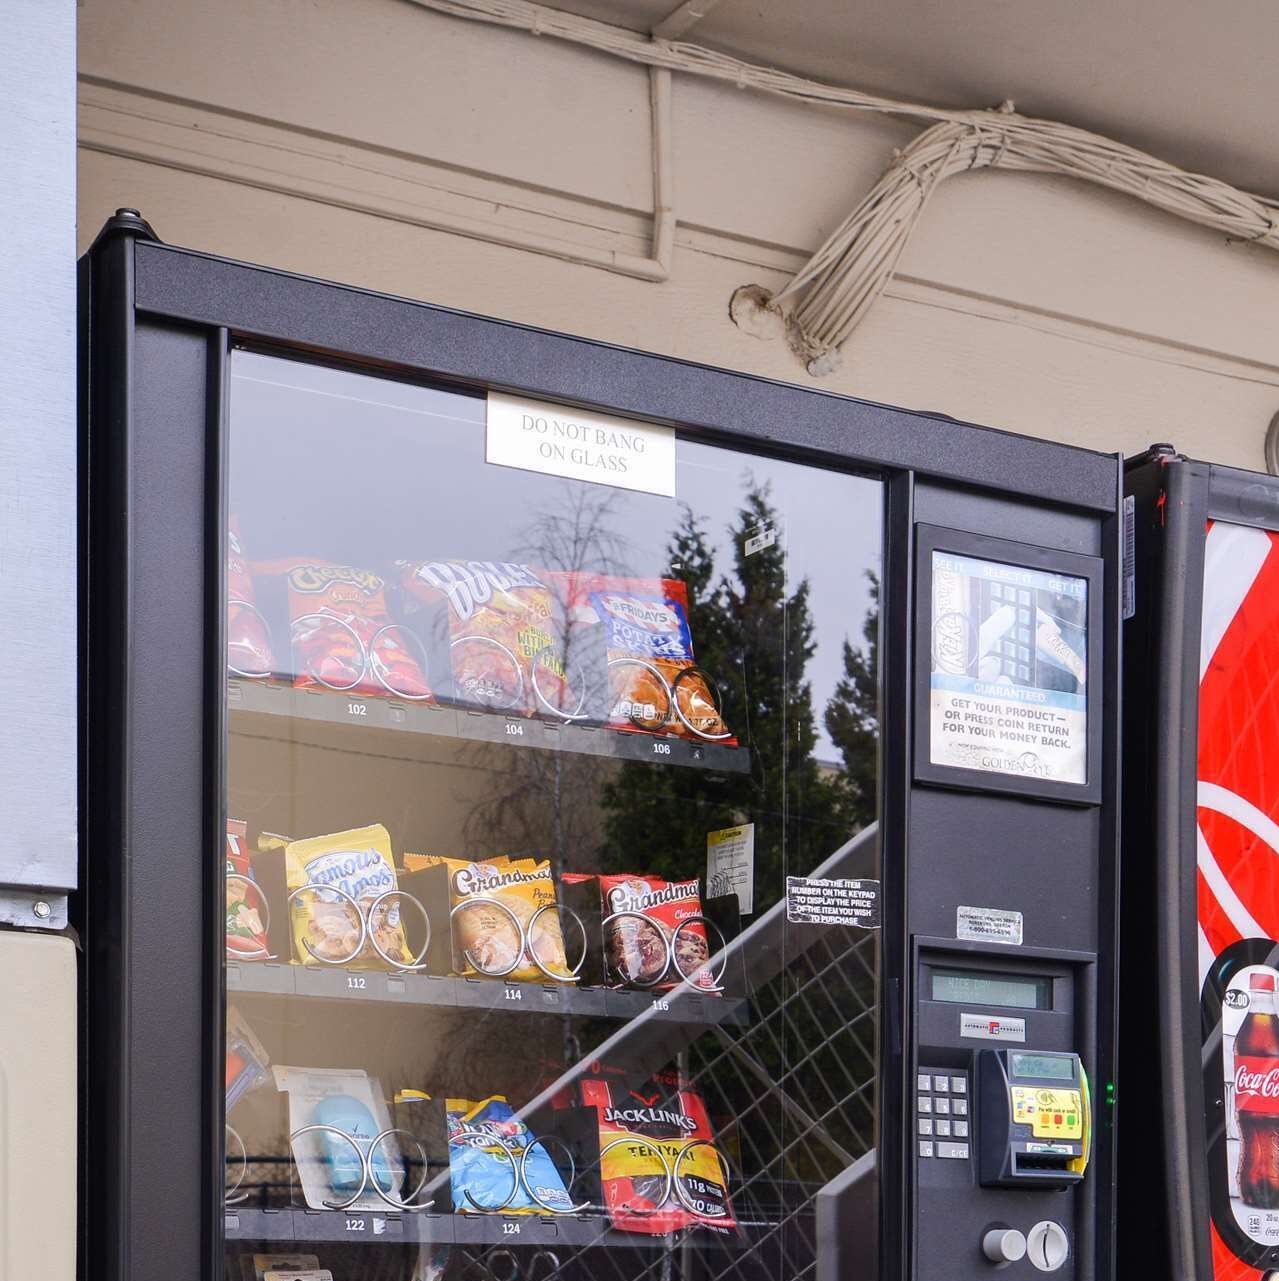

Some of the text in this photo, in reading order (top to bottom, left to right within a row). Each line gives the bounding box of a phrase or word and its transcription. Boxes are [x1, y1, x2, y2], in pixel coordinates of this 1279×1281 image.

[522, 415, 645, 453] DO NOT BANG
[539, 442, 628, 473] ON GLASS
[348, 703, 367, 716] 102
[951, 698, 1002, 714] GET YOUR
[505, 724, 523, 736] 104
[944, 710, 1070, 737] OR PRESS COIN RETURN
[942, 722, 965, 734] FOR
[968, 725, 996, 739] YOUR
[1000, 731, 1037, 745] MONEY
[653, 743, 670, 755] 106
[338, 869, 393, 899] Amos
[830, 880, 843, 888] THE
[845, 881, 861, 889] ITEM
[791, 886, 876, 899] NUMBER ON THE KEYPAD
[807, 897, 836, 906] DISPLAY
[836, 898, 850, 906] THE
[851, 899, 871, 908] PRICE
[808, 906, 821, 914] THE
[822, 907, 838, 915] ITEM
[838, 907, 854, 916] YOU
[854, 909, 872, 917] WISH
[811, 915, 858, 925] TO PURCHASE
[347, 977, 367, 989] 112
[504, 989, 522, 1001] 114
[1225, 993, 1248, 1006] $2.00
[652, 1000, 669, 1011] 116
[605, 1107, 697, 1131] JACK LINK'S
[627, 1145, 695, 1162] TERIYAKI
[687, 1178, 705, 1194] 11g
[346, 1219, 365, 1231] 122
[502, 1223, 521, 1234] 124
